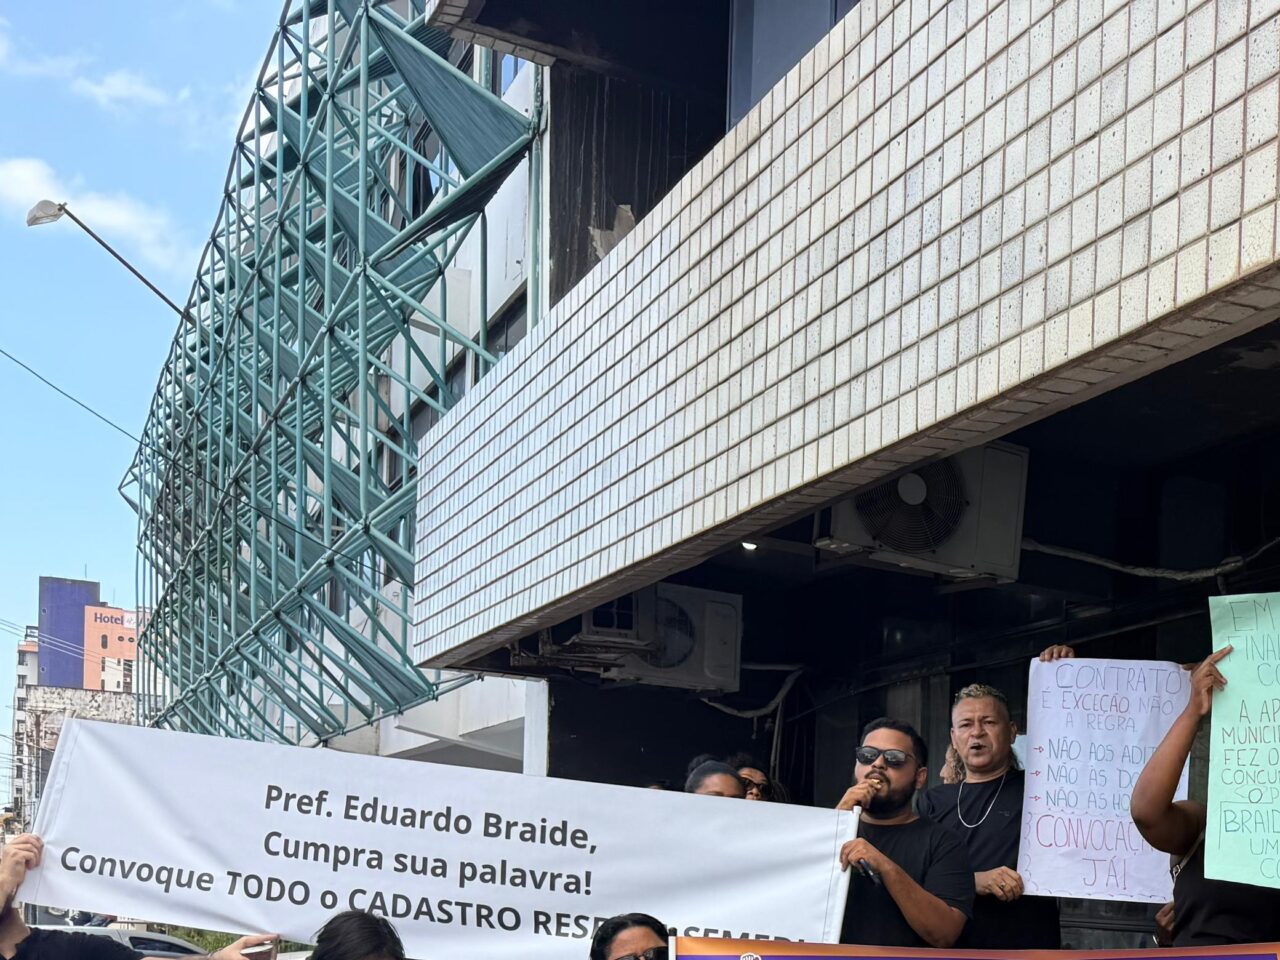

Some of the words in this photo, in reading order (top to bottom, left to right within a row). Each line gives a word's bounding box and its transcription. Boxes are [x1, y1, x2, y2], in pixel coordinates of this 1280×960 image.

[94, 612, 124, 626] Hotel
[1229, 598, 1276, 632] EM
[1056, 663, 1182, 695] CONTRATO
[1042, 686, 1052, 709] É
[1062, 690, 1130, 714] EXCEÇÃO
[1139, 695, 1174, 716] NÃO
[1239, 699, 1251, 724] A
[1066, 714, 1074, 729] A
[1048, 736, 1081, 761] NÃO
[1089, 742, 1115, 761] AOS
[1224, 748, 1260, 767] FEZ
[1047, 762, 1078, 784] NÃO
[1046, 787, 1078, 808] NÃO
[265, 785, 333, 817] Pref.
[343, 795, 472, 834] Eduardo
[483, 812, 598, 854] Braide,
[1036, 814, 1153, 856] CONVOCAÇ
[264, 831, 383, 872] Cumpra
[393, 851, 448, 878] sua
[459, 859, 593, 895] palavra!
[1082, 856, 1128, 890] JÁ!
[60, 847, 214, 893] Convoque
[226, 871, 310, 906] TODO
[320, 890, 338, 909] o
[349, 888, 522, 932] CADASTRO
